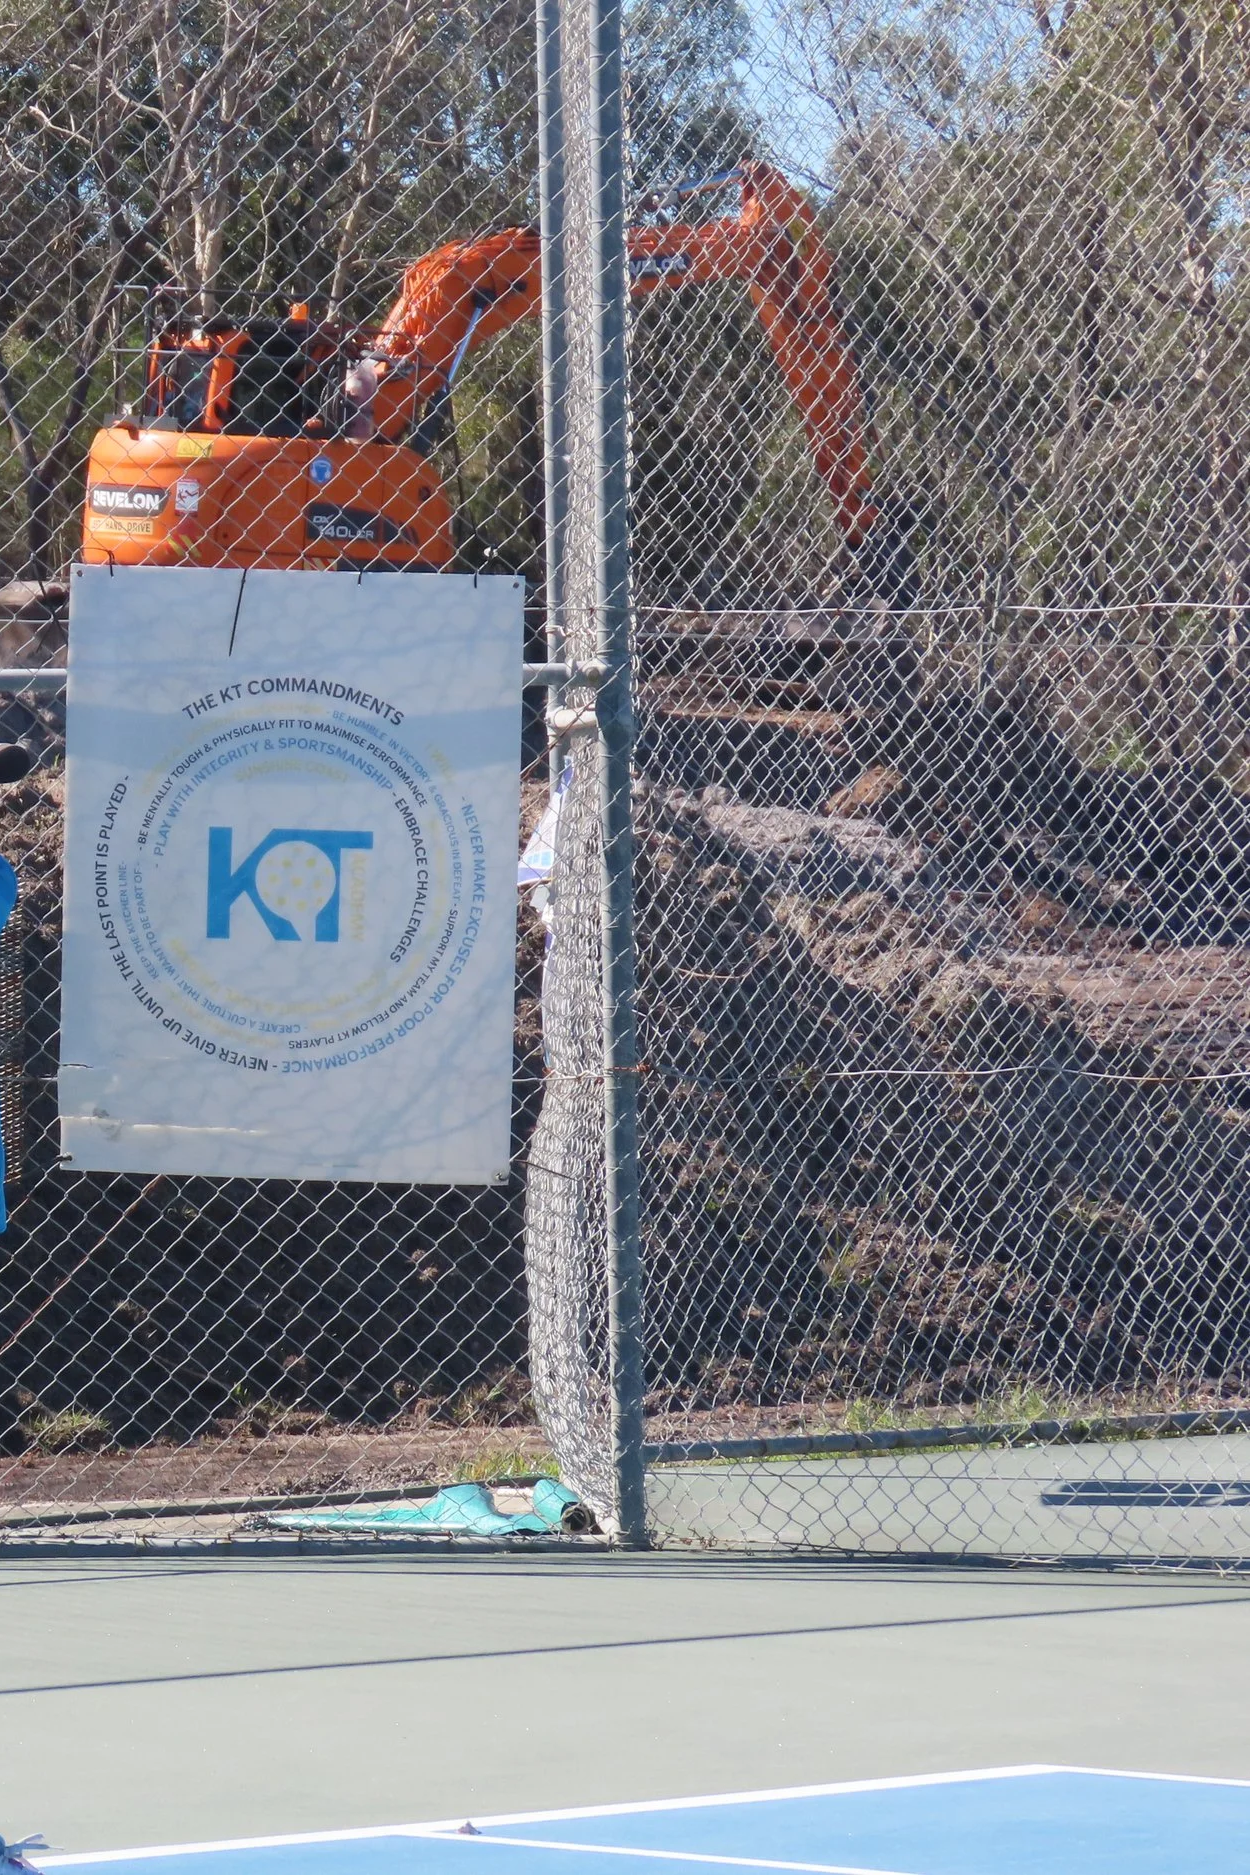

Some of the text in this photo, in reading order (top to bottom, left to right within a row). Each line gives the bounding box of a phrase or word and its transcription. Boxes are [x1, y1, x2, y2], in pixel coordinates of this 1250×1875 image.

[93, 490, 160, 510] DEVELON
[181, 692, 218, 721] THE
[217, 682, 244, 704] KT
[246, 676, 407, 727] COMMANDMENTS
[331, 709, 346, 721] BE
[210, 718, 276, 748] PHYSICALLY
[278, 718, 295, 728] FIT
[296, 718, 312, 729] TO
[313, 720, 368, 748] MAXIMISE
[345, 714, 389, 742] HUMBLE
[201, 741, 213, 753] &
[387, 737, 400, 750] IN
[170, 747, 204, 780] TOUGH
[365, 741, 430, 808] PERFORMANCE
[396, 745, 433, 785] VICTORY
[96, 780, 129, 840] PLAYED
[140, 776, 175, 828] MENTALLY
[151, 818, 173, 856] PLAY
[164, 782, 195, 819] WITH
[189, 739, 261, 787] INTEGRITY
[262, 737, 275, 751] &
[277, 736, 396, 793] SPORTSMANSHIP
[392, 796, 429, 866] EMBRACE
[432, 792, 459, 848] GRACIOUS
[460, 803, 485, 855] NEVER
[94, 841, 109, 857] IS
[136, 829, 149, 844] BE
[451, 848, 461, 860] IN
[94, 860, 109, 909] POINT
[133, 867, 142, 883] OF
[206, 826, 373, 942] KT
[451, 861, 462, 901] DEFEAT
[471, 858, 486, 903] MAKE
[118, 888, 136, 934] KITCHEN
[133, 885, 146, 914] PART
[97, 910, 121, 951] LAST
[138, 914, 151, 931] BE
[387, 869, 429, 965] CHALLENGES
[129, 934, 145, 955] THE
[143, 930, 158, 947] TO
[434, 908, 459, 957] SUPPORT
[447, 906, 484, 976] EXCUSES
[111, 949, 135, 981] THE
[138, 953, 160, 980] KEEP
[151, 945, 177, 977] WANT
[424, 955, 441, 974] MY
[127, 978, 165, 1019] UNTIL
[175, 977, 201, 1002] THAT
[405, 970, 431, 998] TEAM
[428, 974, 456, 1006] FOR
[199, 996, 247, 1027] CULTURE
[387, 993, 410, 1015] AND
[159, 1013, 183, 1036] UP
[246, 1018, 257, 1030] A
[257, 1020, 301, 1034] CREATE
[349, 1009, 391, 1037] FELLOW
[393, 1001, 434, 1039] POOR
[179, 1028, 218, 1057] GIVE
[288, 1034, 335, 1049] PLAYERS
[334, 1029, 350, 1042] KT
[215, 1046, 268, 1072] NEVER
[281, 1031, 396, 1073] PERFORMANCE
